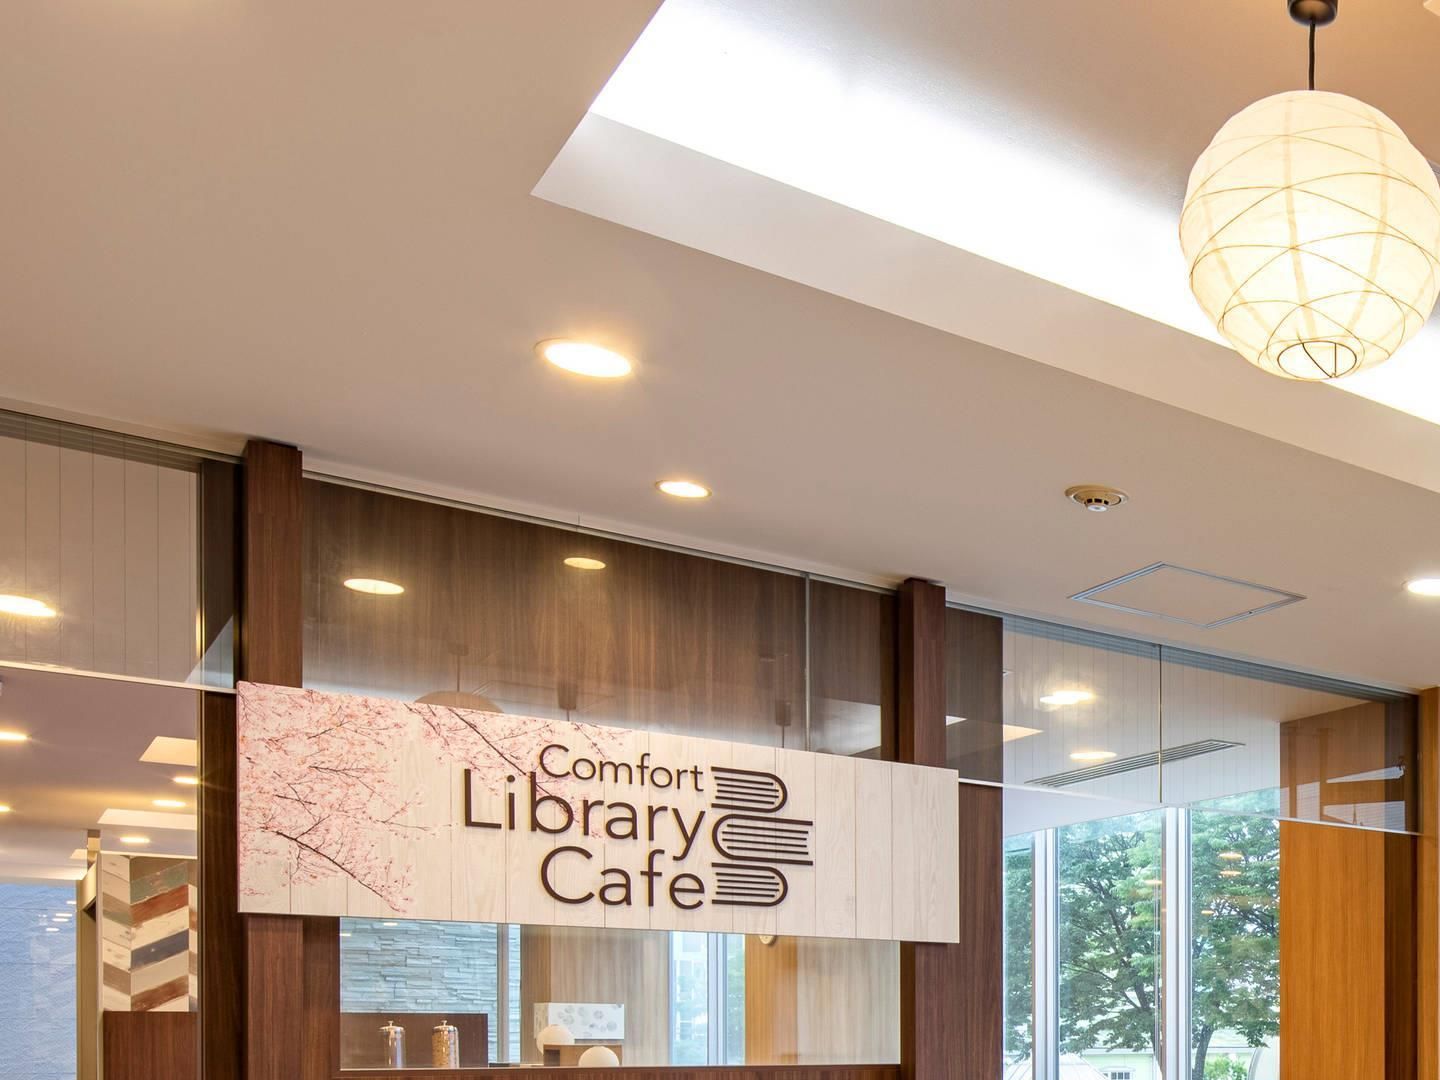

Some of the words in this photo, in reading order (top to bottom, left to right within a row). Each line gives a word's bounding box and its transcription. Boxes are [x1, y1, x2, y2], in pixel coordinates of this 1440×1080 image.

[538, 743, 705, 793] Comfort
[463, 768, 707, 860] Library
[540, 845, 706, 910] Cafe
